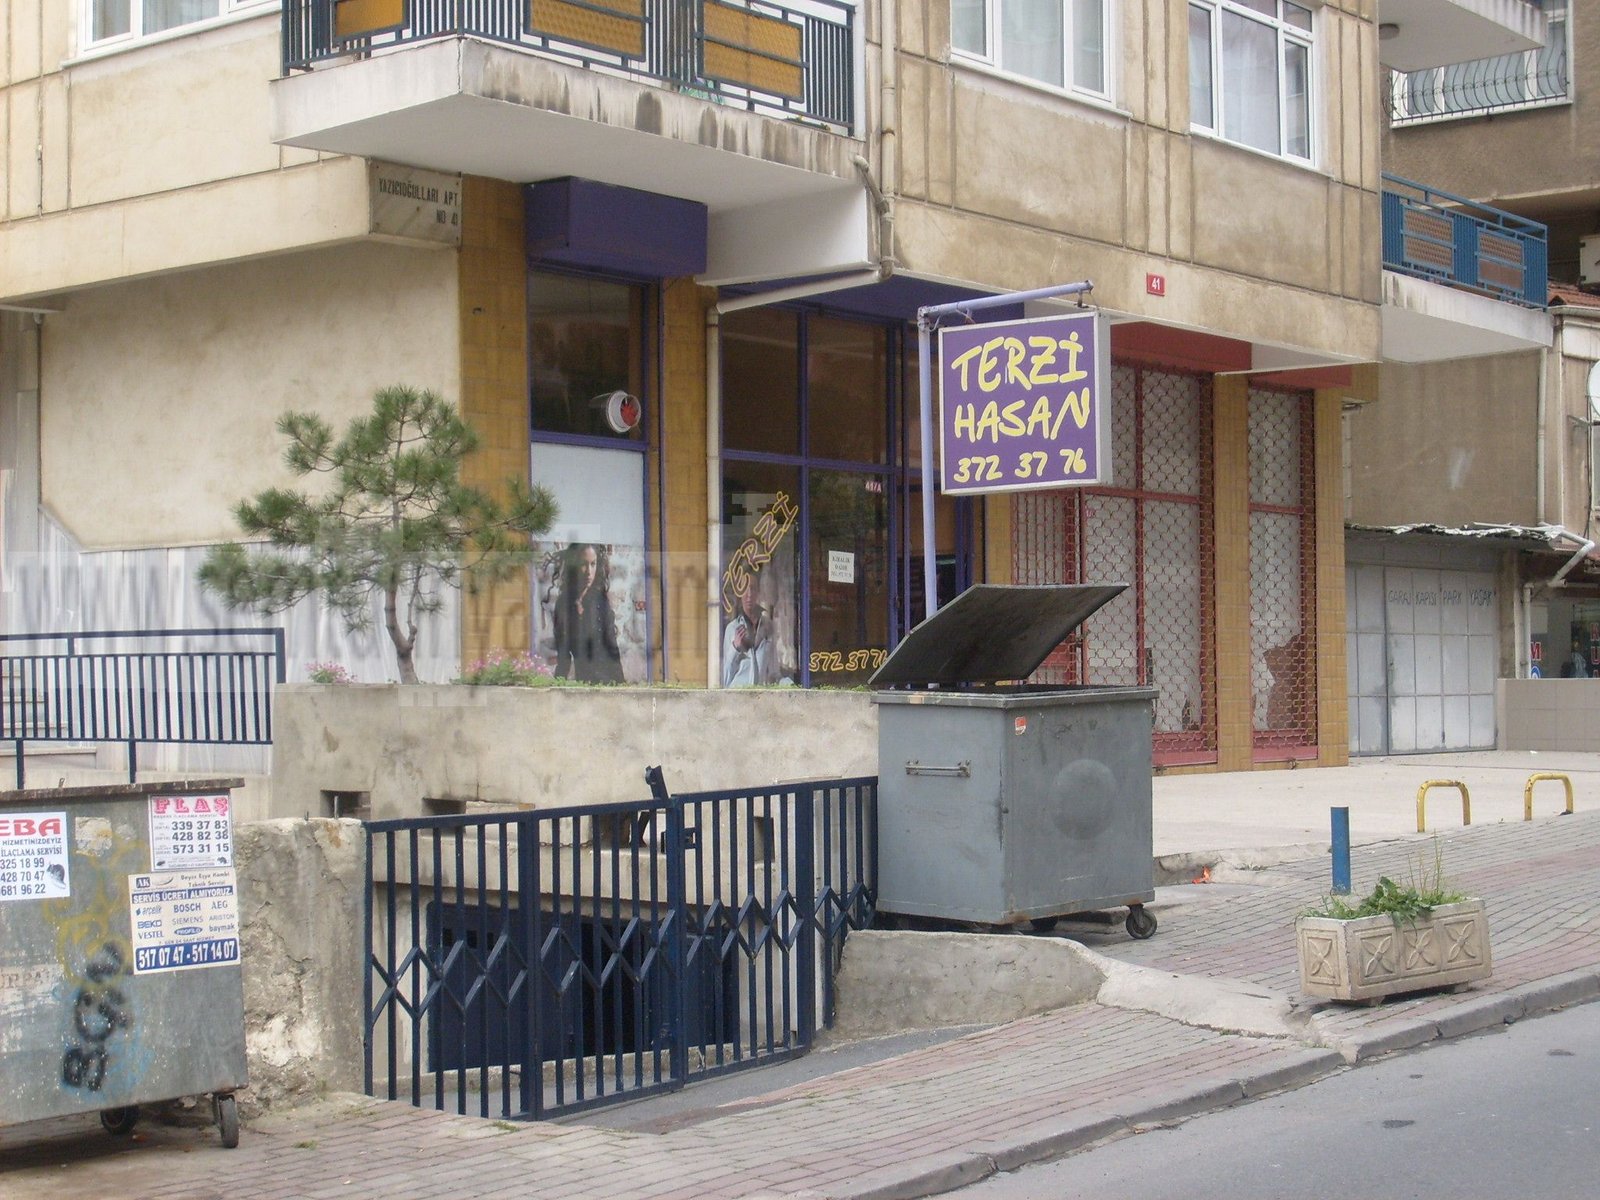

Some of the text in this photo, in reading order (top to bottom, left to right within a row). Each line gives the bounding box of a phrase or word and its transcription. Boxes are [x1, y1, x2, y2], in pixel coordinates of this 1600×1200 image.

[444, 190, 458, 206] APT
[436, 209, 446, 224] NO
[1152, 277, 1161, 291] 41
[951, 331, 1087, 392] TERZİ
[954, 387, 1090, 443] HASAN
[953, 447, 1087, 483] 372 37 76
[808, 651, 844, 673] 372
[845, 649, 870, 671] 37
[154, 797, 228, 816] FLAŞ
[171, 821, 193, 830] 339
[197, 820, 210, 830] 37
[214, 820, 228, 829] 83
[172, 831, 193, 841] 428
[197, 831, 211, 840] 82
[172, 844, 194, 854] 573
[198, 844, 210, 853] 31
[216, 843, 229, 852] 15
[0, 857, 45, 870] 325 18 99
[0, 870, 45, 883] 428 70 47
[137, 878, 150, 887] AK
[1, 883, 46, 896] 681 96 22
[133, 893, 161, 904] SERVİS
[162, 890, 189, 901] ÜCRETİ
[173, 902, 202, 913] BOSCH
[211, 900, 228, 909] AEG
[137, 913, 235, 929] BEKO SIEMENS ARISTON
[138, 931, 165, 940] VESTEL
[209, 923, 235, 933] baymak
[138, 949, 157, 968] 517
[158, 947, 171, 966] 07
[173, 945, 185, 964] 47
[192, 943, 209, 962] 517
[210, 941, 222, 960] 14
[223, 940, 236, 958] 07
